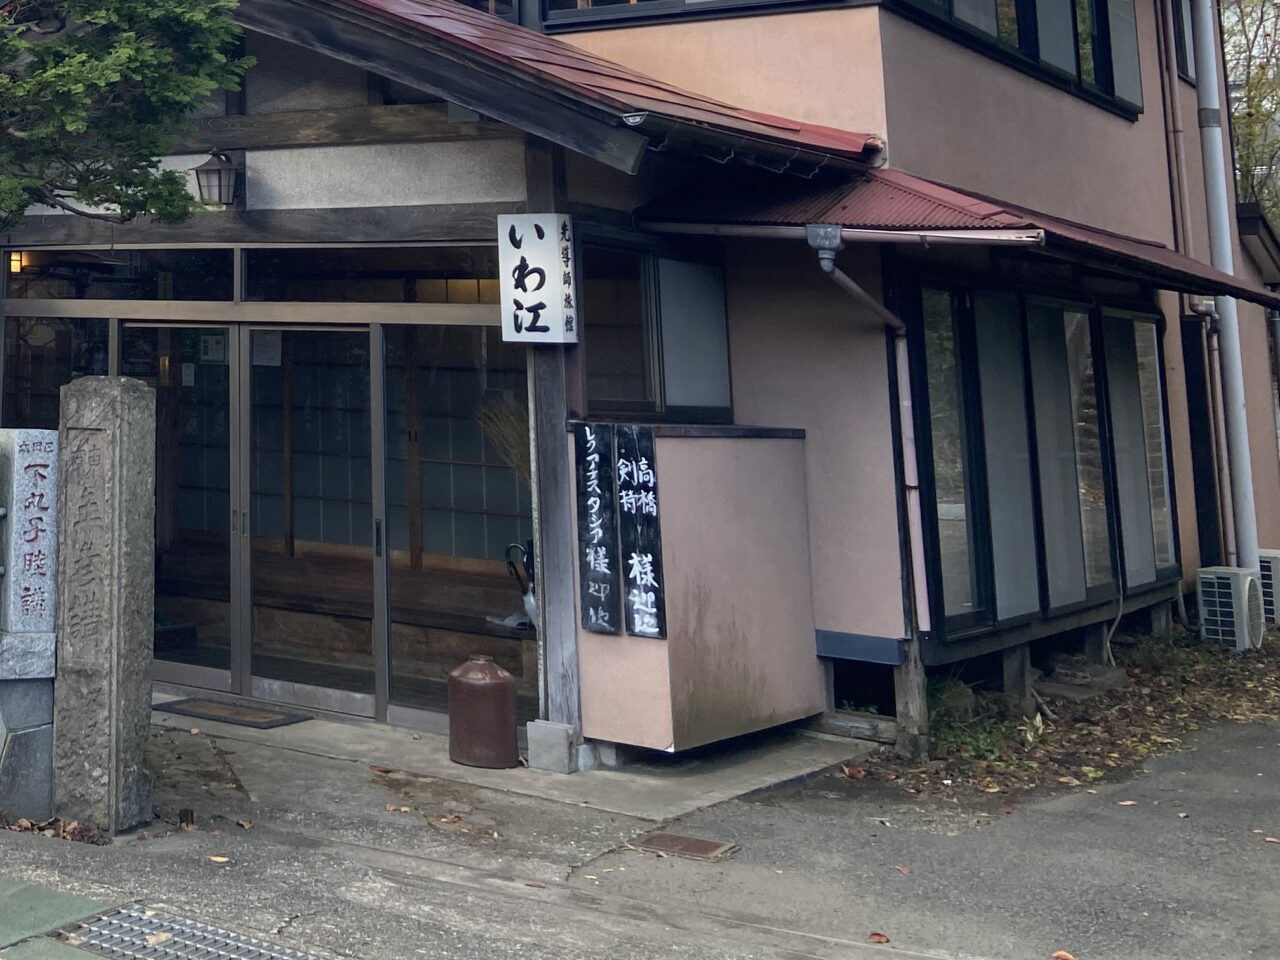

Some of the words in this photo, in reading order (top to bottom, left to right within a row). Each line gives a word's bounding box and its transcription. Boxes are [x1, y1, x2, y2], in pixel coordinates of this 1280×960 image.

[508, 223, 550, 333] いわ江
[560, 220, 575, 333] 先導師旅館
[636, 456, 658, 518] 高橋
